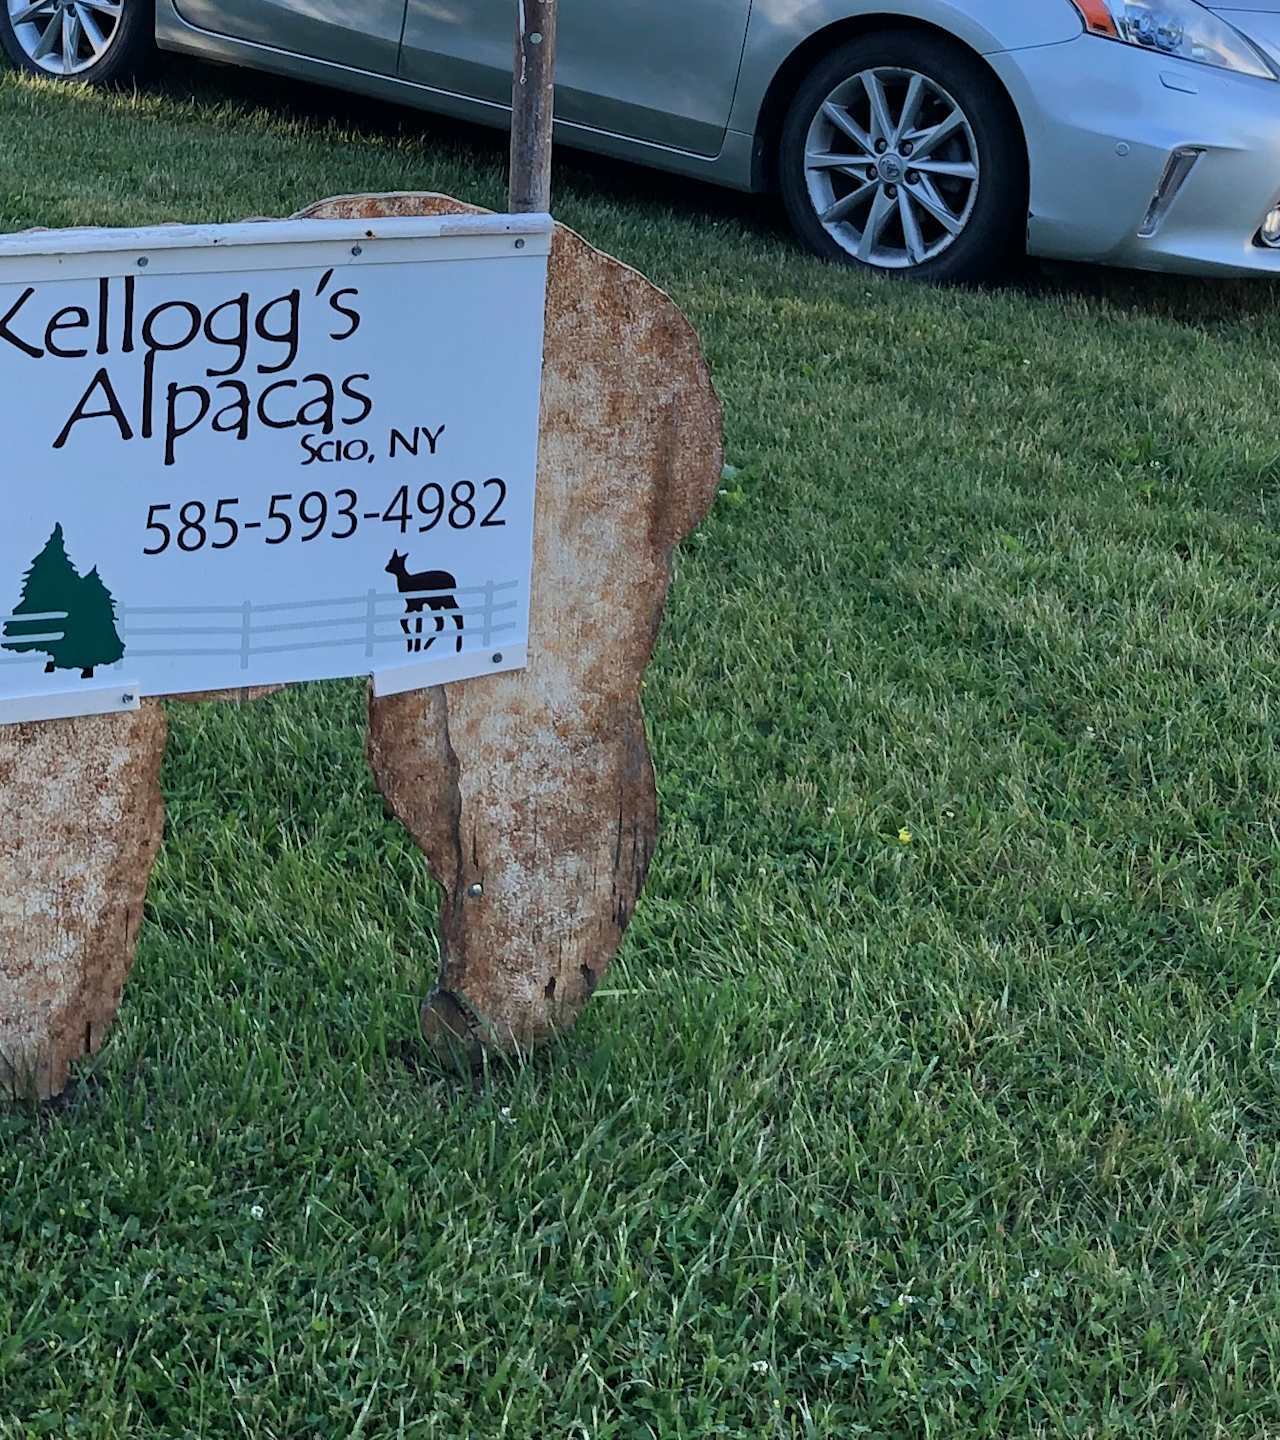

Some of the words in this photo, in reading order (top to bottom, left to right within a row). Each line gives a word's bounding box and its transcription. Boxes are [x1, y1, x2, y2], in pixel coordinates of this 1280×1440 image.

[53, 349, 371, 465] Alpacas
[389, 424, 446, 457] NY
[142, 477, 508, 555] 585-593-4982
